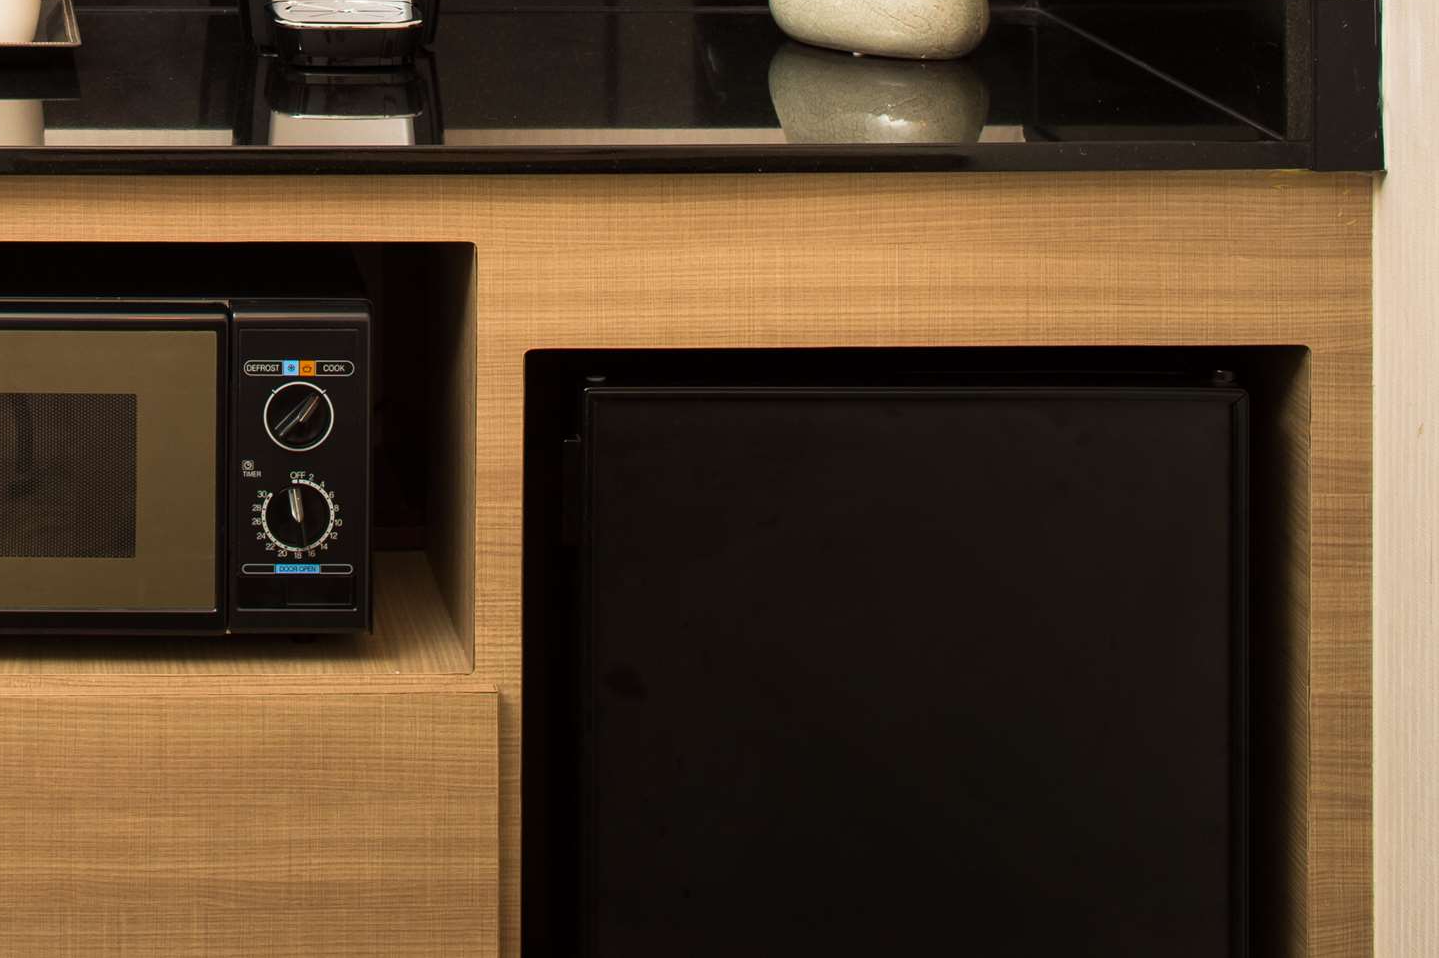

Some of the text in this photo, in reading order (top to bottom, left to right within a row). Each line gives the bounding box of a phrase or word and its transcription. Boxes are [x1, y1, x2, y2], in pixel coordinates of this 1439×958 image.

[246, 364, 280, 372] DEFROST
[322, 364, 345, 372] COOK
[290, 471, 306, 479] OFF
[308, 473, 315, 481] 2
[257, 490, 267, 498] 30
[329, 491, 334, 499] 6
[252, 504, 262, 512] 28
[333, 504, 339, 512] 8
[252, 517, 262, 526] 26
[335, 519, 343, 527] 10
[256, 532, 266, 540] 24
[330, 531, 338, 540] 12
[265, 542, 275, 551] 22
[321, 542, 328, 550] 14
[278, 549, 288, 557] 20
[307, 549, 316, 557] 16
